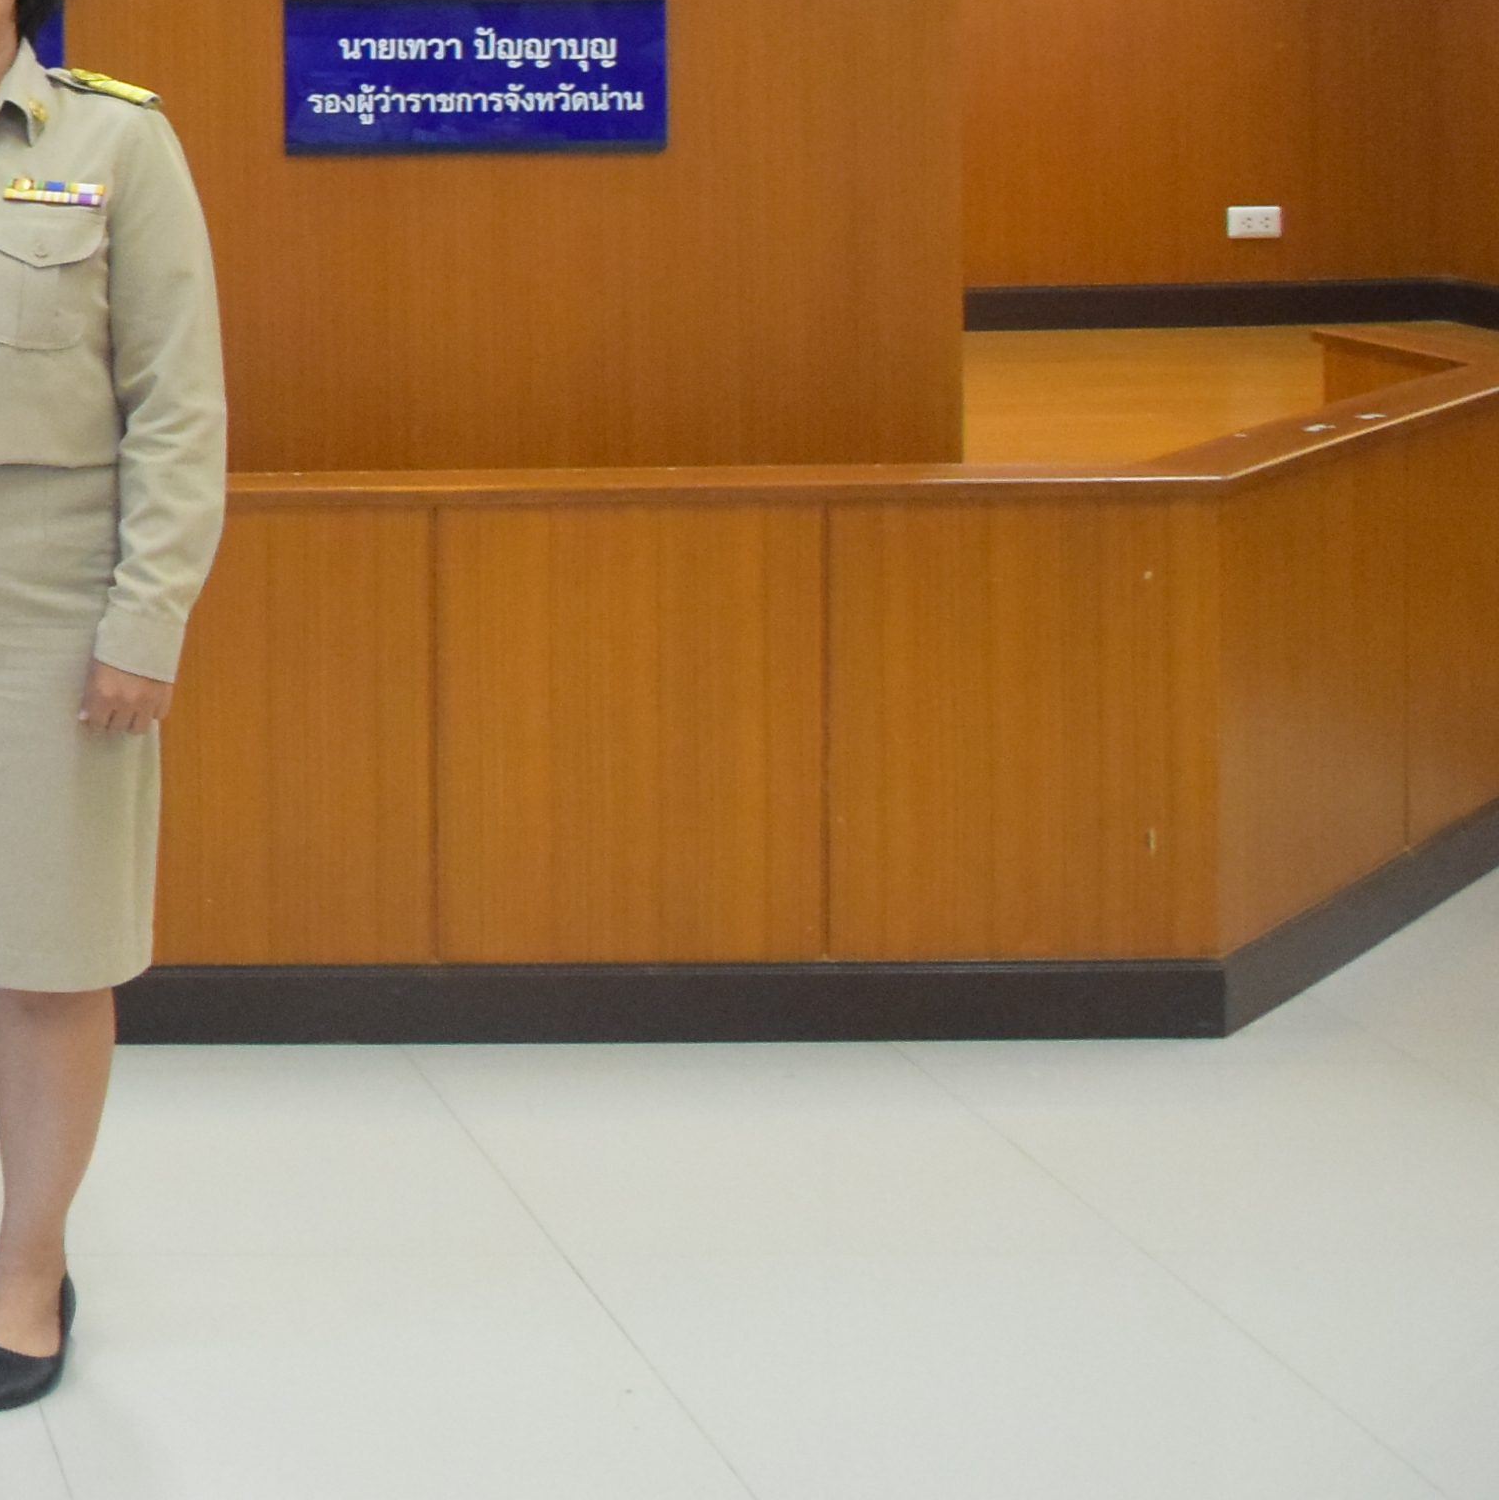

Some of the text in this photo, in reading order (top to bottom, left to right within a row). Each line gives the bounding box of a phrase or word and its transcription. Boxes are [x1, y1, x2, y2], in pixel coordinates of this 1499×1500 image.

[338, 27, 617, 72] นายเทวา ปัญญาบุญ
[307, 83, 645, 125] รองผู้ว่าราชการจังหวัดน่าน
